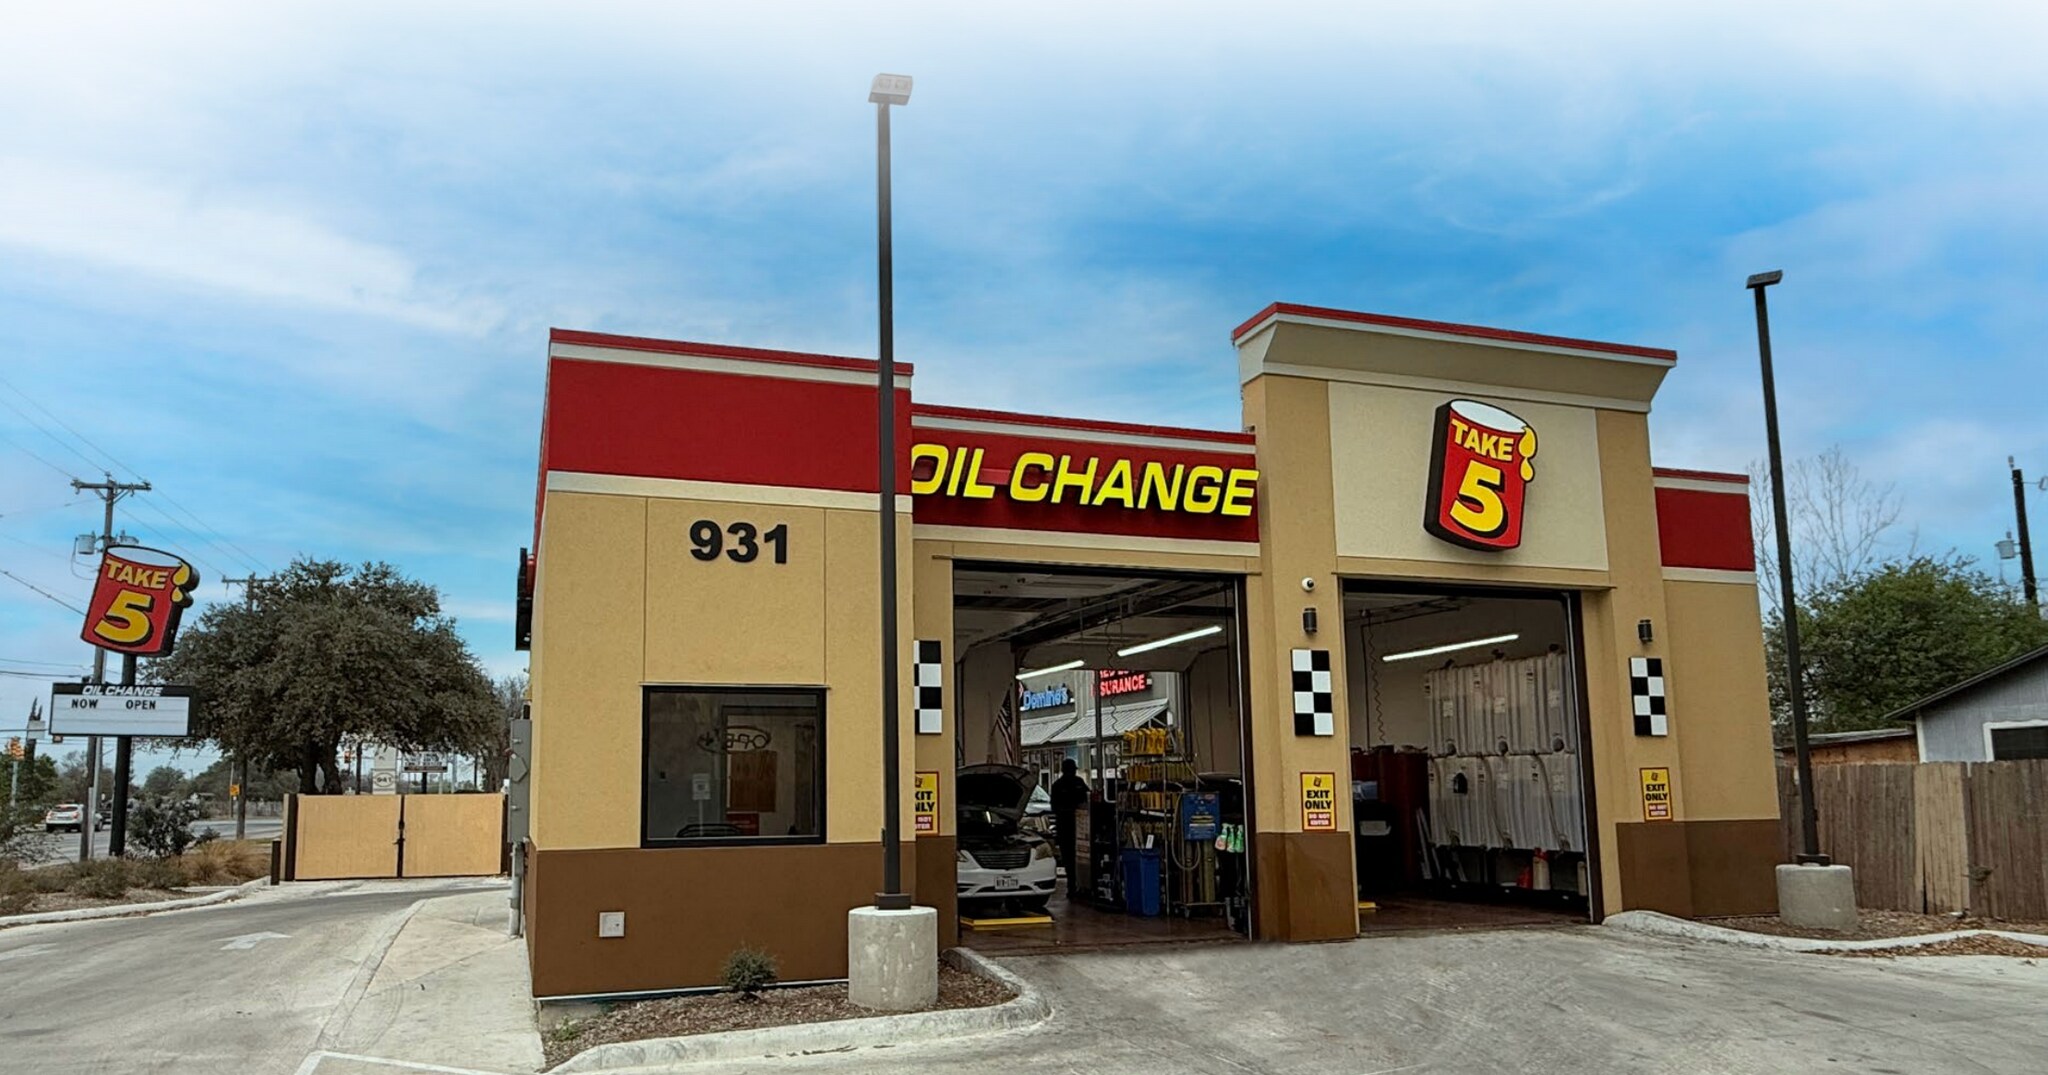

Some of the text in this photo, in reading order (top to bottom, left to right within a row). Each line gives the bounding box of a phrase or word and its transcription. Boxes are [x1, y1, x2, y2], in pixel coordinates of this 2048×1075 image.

[1451, 418, 1514, 461] TAKE
[911, 443, 1260, 516] OIL CHANGE
[1450, 459, 1505, 533] 5
[689, 519, 788, 565] 931
[105, 558, 170, 589] TAKE
[94, 589, 152, 644] 5
[82, 685, 163, 696] OIL CHANGE
[71, 698, 156, 710] NOW OPEN
[1646, 784, 1666, 792] EXIT
[915, 790, 933, 801] XIT
[1306, 790, 1330, 799] EXIT
[1645, 792, 1668, 801] ONLY
[915, 801, 935, 812] NLY
[1305, 800, 1332, 810] ONLY
